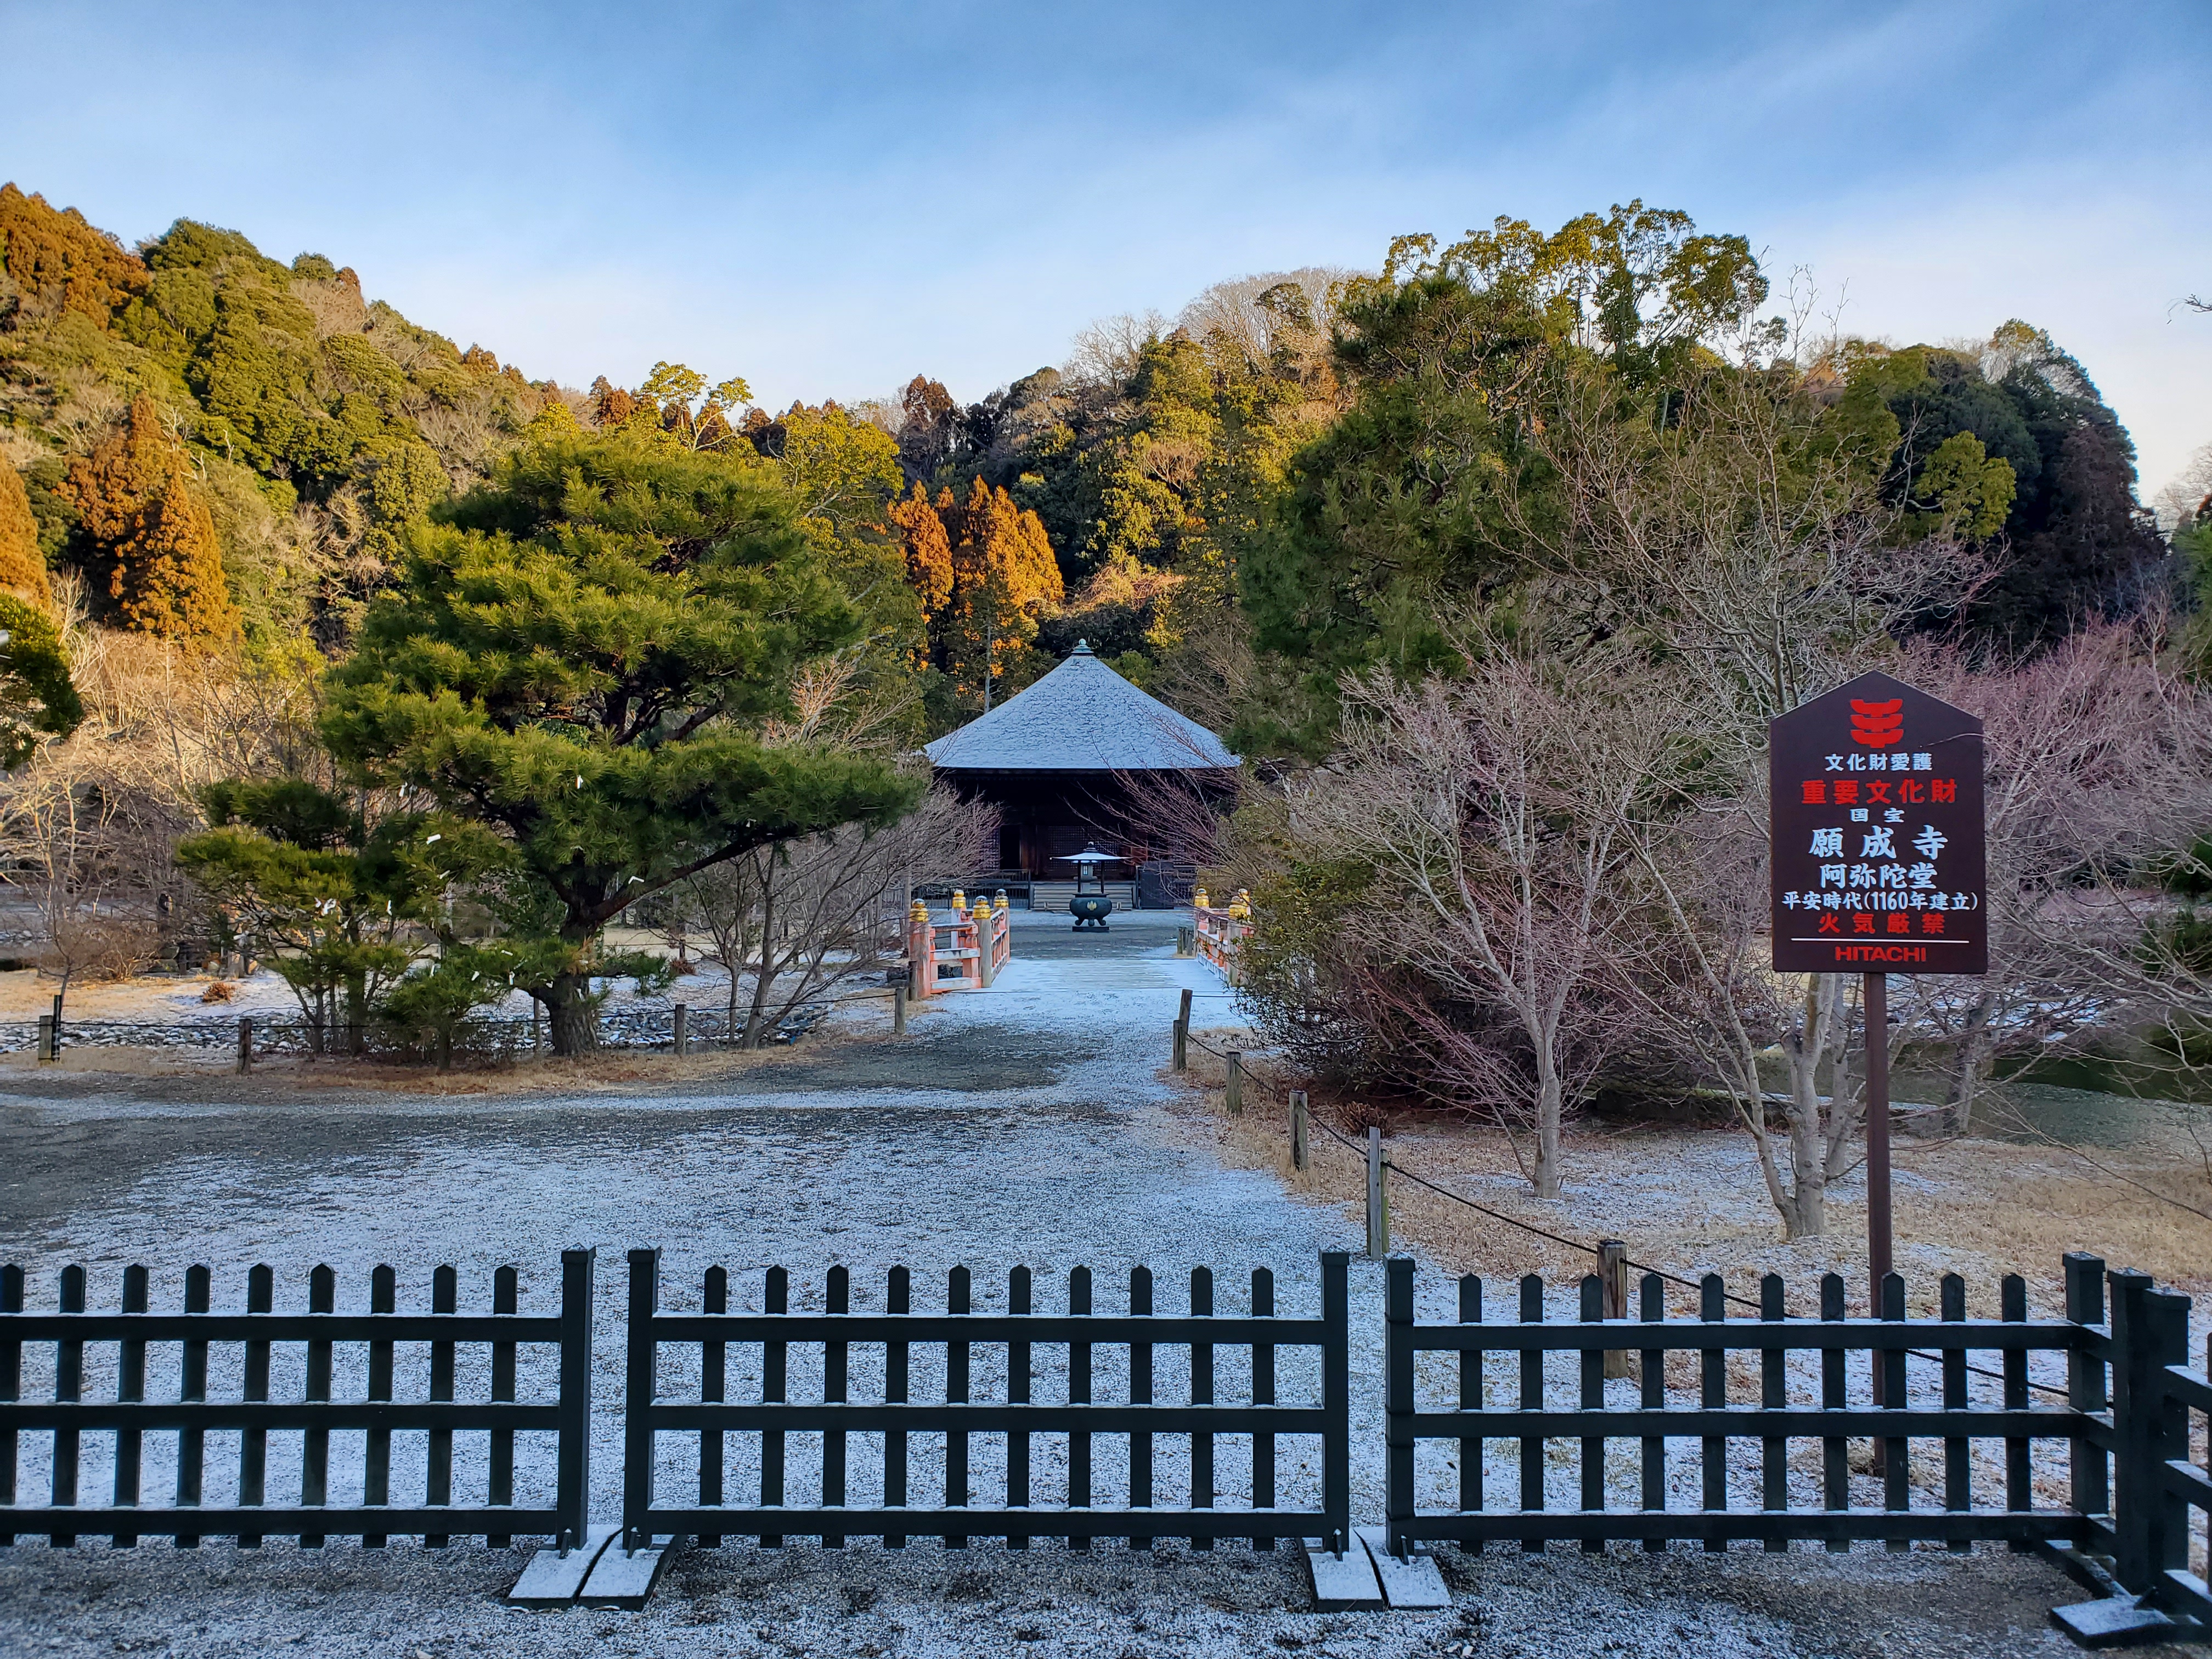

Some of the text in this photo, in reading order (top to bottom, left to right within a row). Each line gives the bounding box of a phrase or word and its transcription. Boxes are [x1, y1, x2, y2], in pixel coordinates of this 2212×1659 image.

[1825, 752, 1933, 771] 文化財愛護
[1801, 778, 1957, 805] 重要文化財
[1849, 808, 1905, 823] 国宝
[1808, 825, 1948, 860] 願成寺
[1819, 861, 1938, 889] 阿弥陀堂
[1781, 890, 1978, 911] 平安時代(1160年建立)
[1818, 912, 1945, 934] 火気厳禁
[1835, 946, 1927, 962] HITACHI
